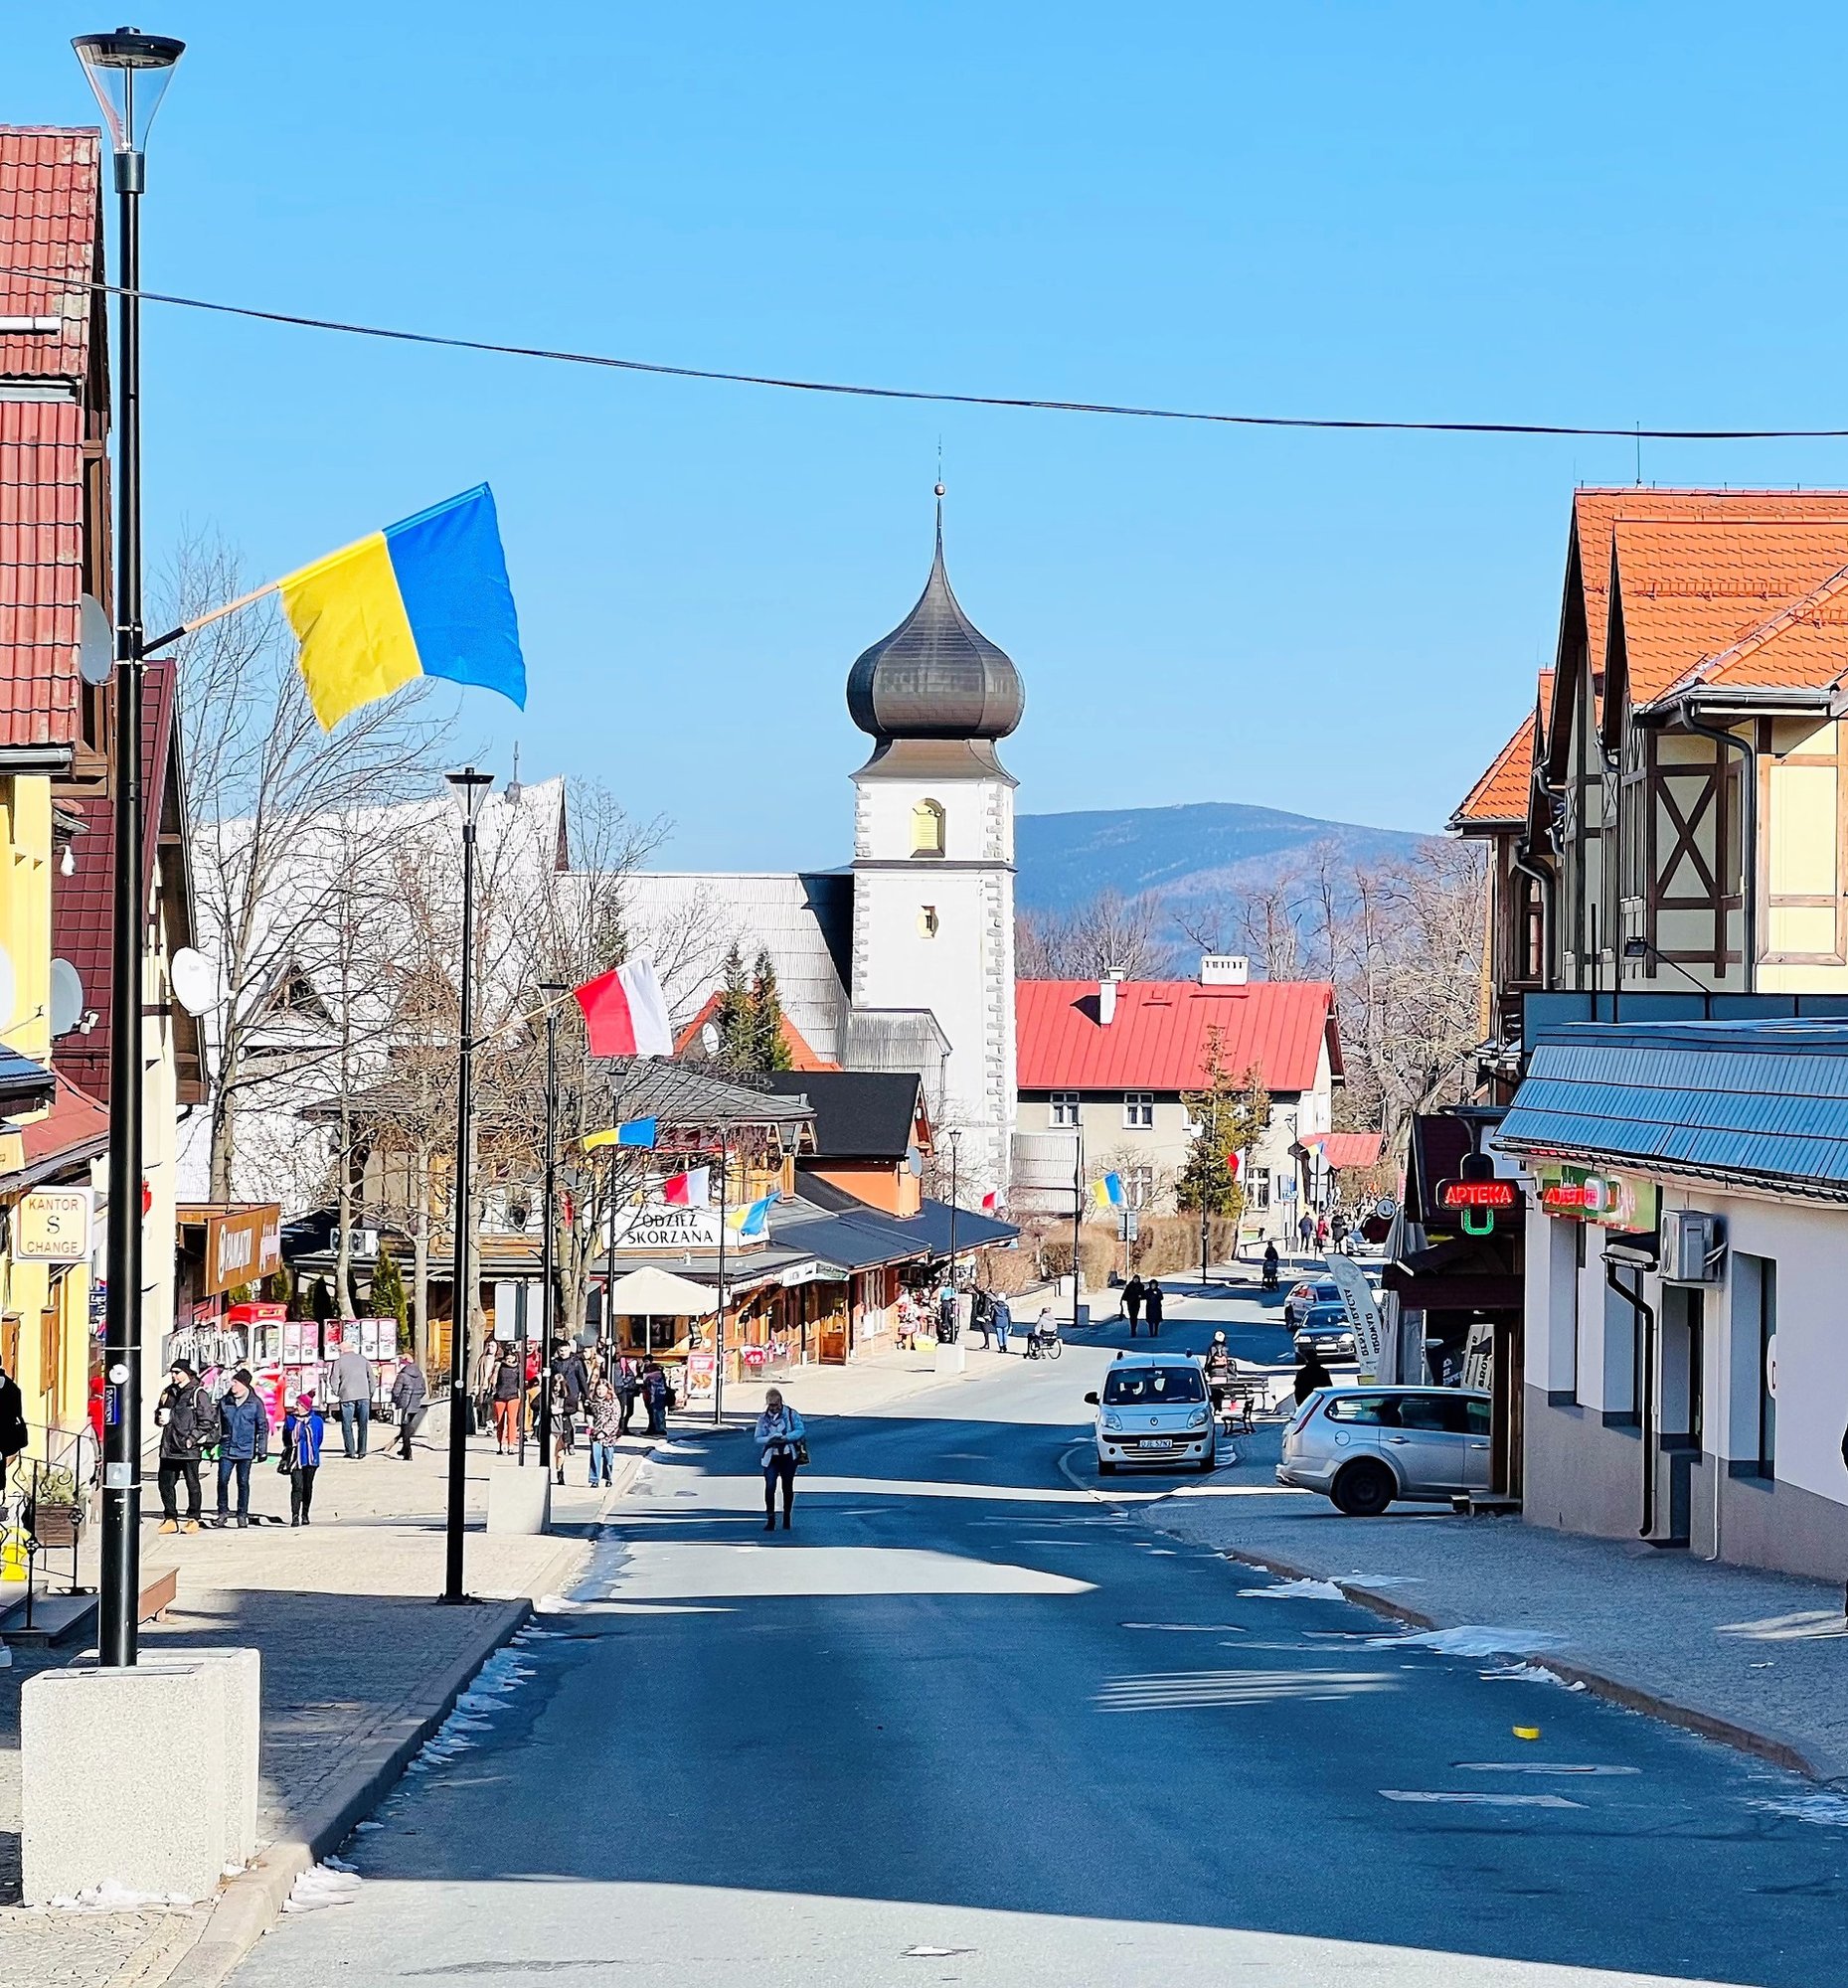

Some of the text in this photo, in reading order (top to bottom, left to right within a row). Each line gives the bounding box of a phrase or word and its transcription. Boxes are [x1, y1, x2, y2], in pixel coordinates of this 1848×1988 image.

[1443, 1185, 1513, 1205] APTEKA
[28, 1198, 79, 1212] KANTOR
[27, 1241, 79, 1254] CHANGE
